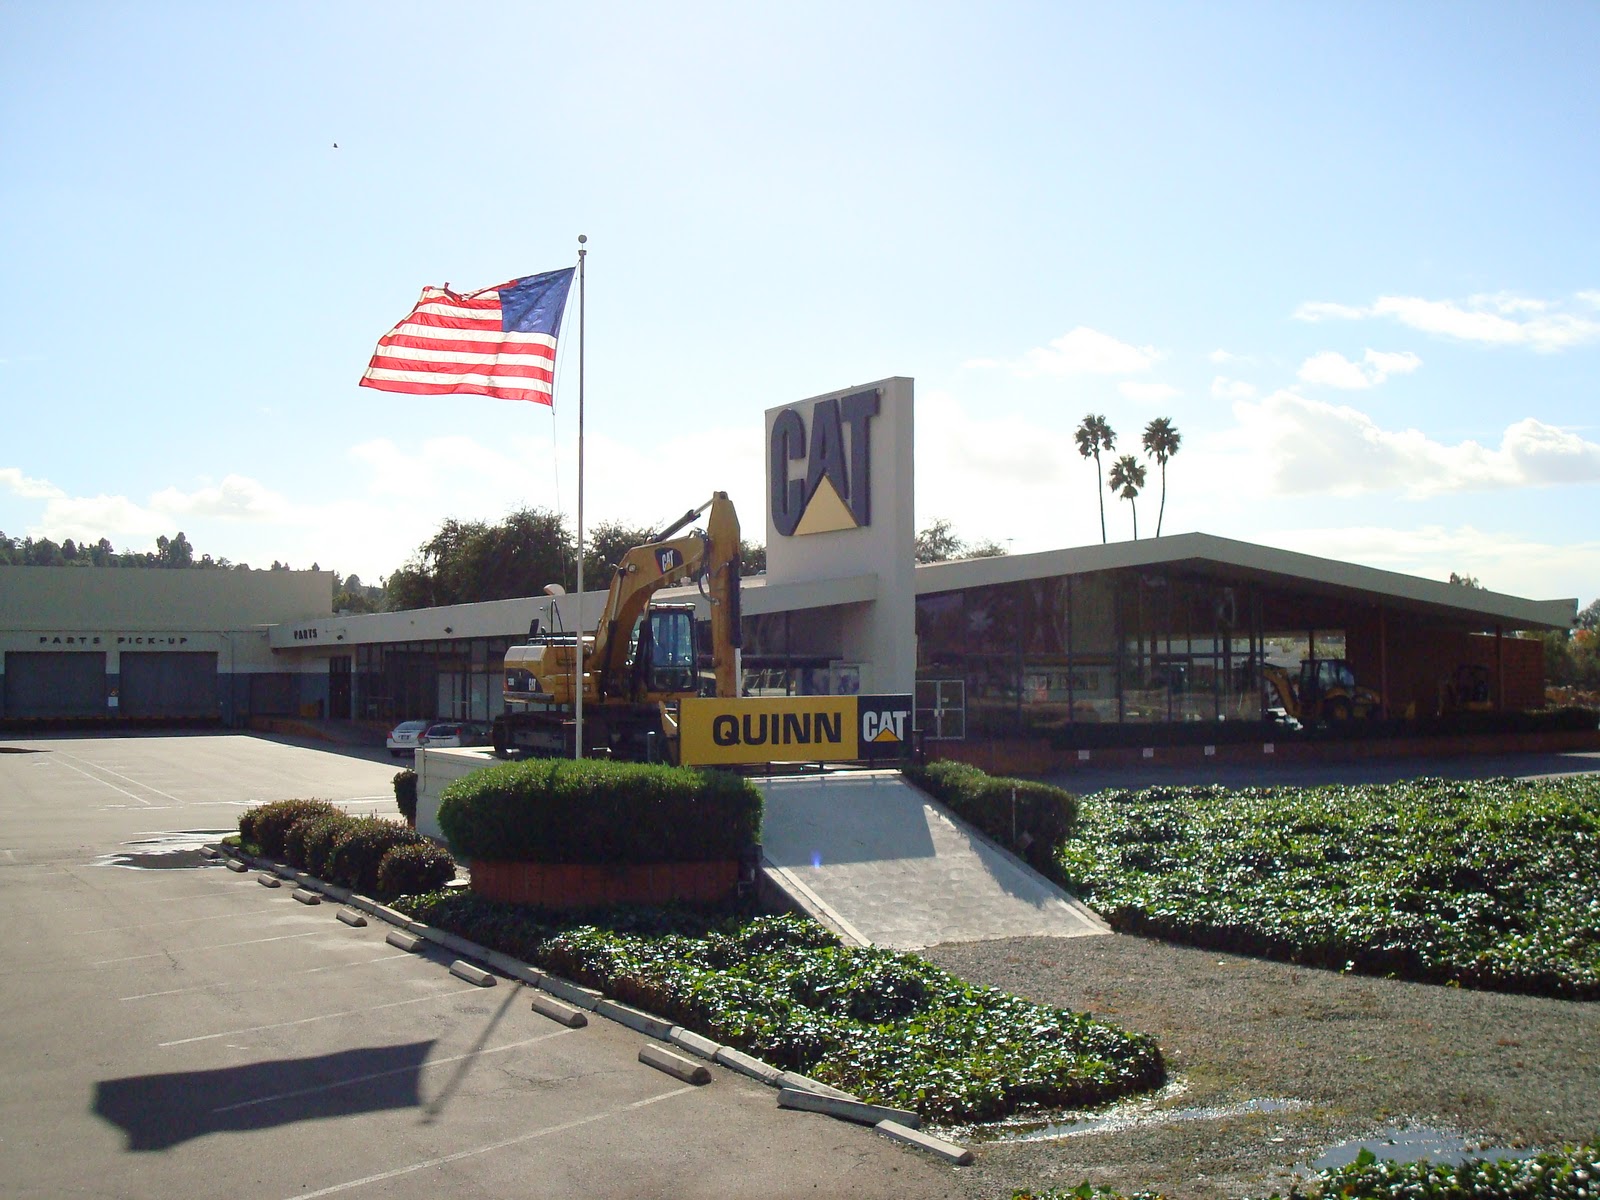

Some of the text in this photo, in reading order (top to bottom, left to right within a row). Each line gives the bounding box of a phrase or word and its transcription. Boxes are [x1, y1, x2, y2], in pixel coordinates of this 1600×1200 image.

[771, 388, 880, 536] CAT
[662, 550, 673, 571] CAT
[294, 628, 317, 639] PARTS
[713, 711, 907, 746] QUINN CAT
